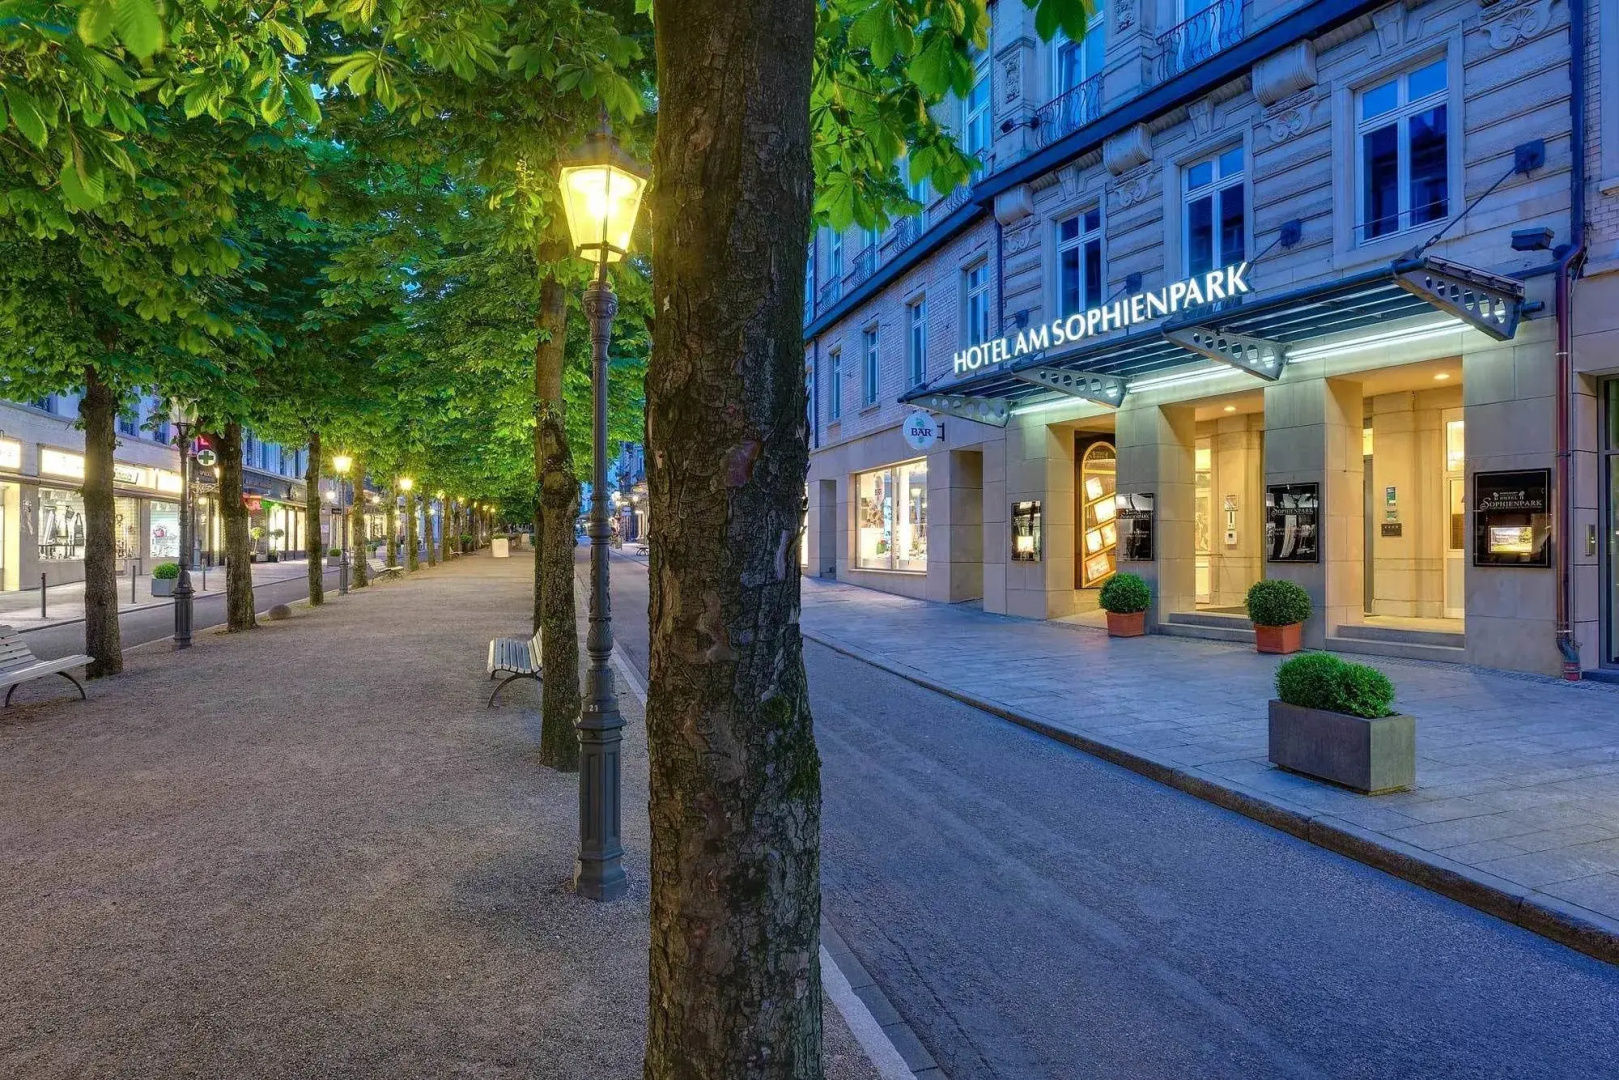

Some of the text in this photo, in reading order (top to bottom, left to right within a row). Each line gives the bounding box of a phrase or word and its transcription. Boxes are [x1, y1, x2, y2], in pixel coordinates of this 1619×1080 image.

[953, 261, 1250, 373] HOTEL AM SOPHIENPARK
